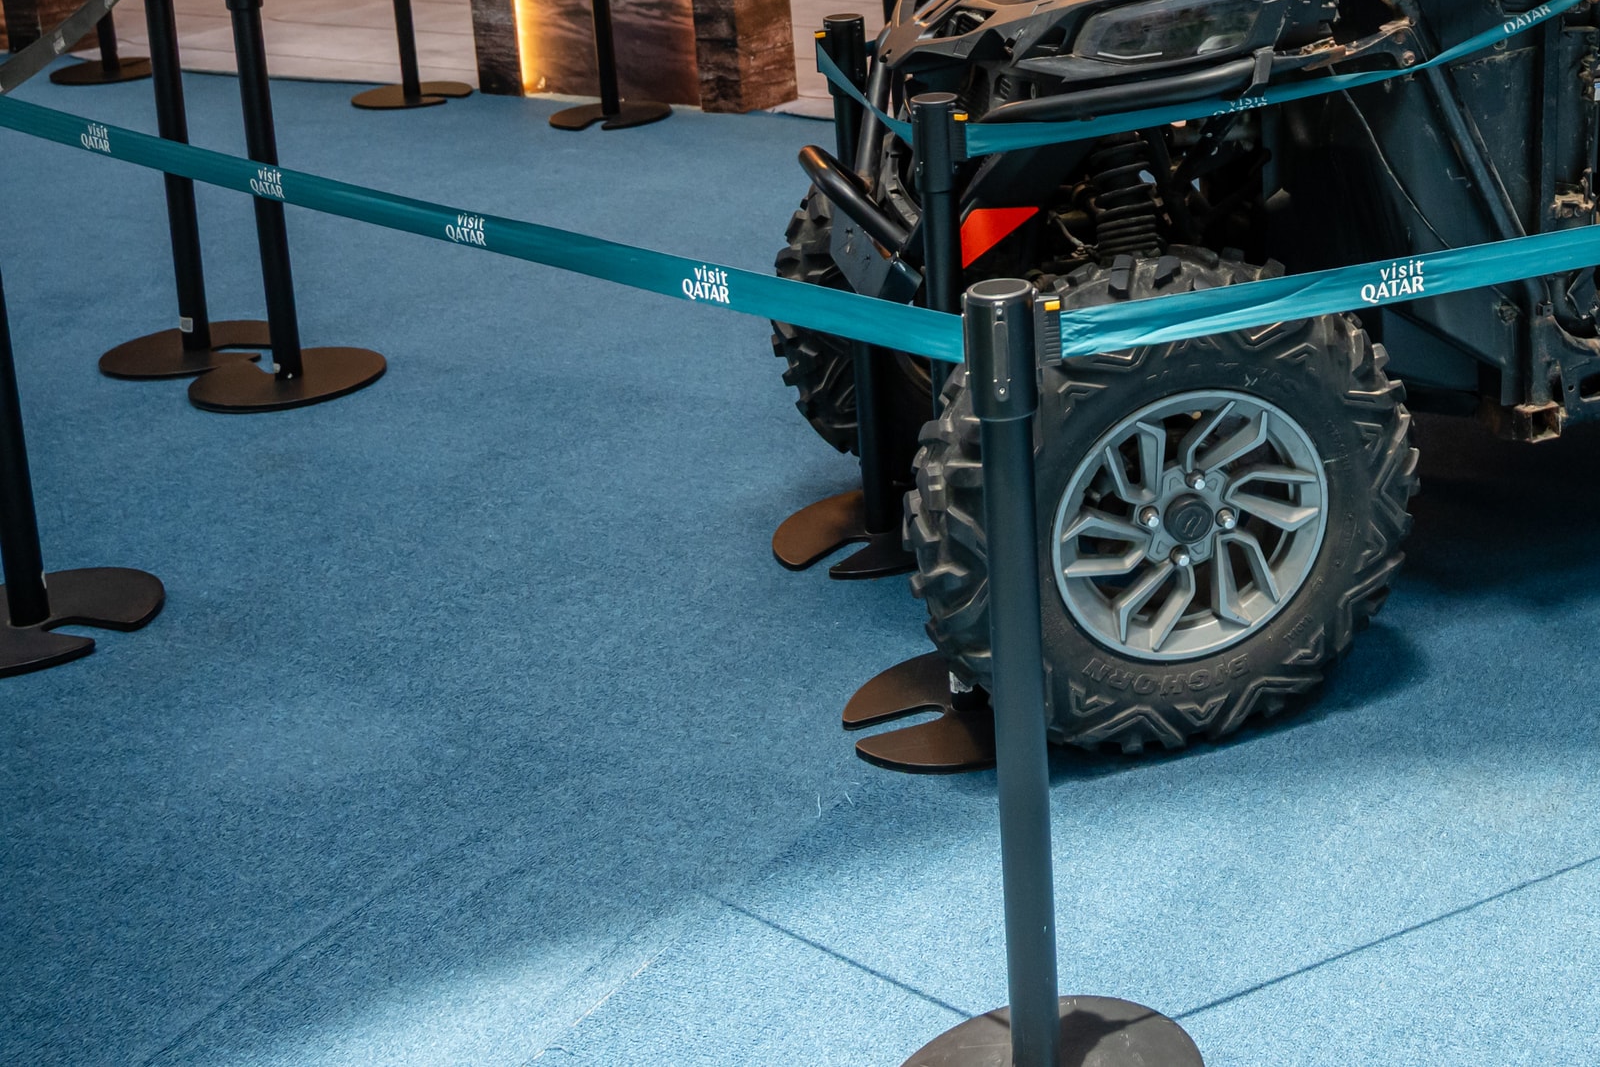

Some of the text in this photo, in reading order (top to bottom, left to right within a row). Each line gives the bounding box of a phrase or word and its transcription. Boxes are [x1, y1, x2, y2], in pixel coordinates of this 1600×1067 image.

[1503, 4, 1552, 34] QATAR
[88, 123, 109, 140] visit
[81, 133, 111, 154] QATAR
[257, 167, 282, 185] visit
[250, 178, 285, 199] QATAR
[457, 213, 485, 231] visit
[445, 224, 487, 247] QATAR
[694, 265, 728, 286] visit
[1380, 260, 1425, 281] visit
[682, 278, 730, 304] QATAR
[1361, 276, 1425, 303] QATAR
[1081, 653, 1249, 697] BIGHORN
